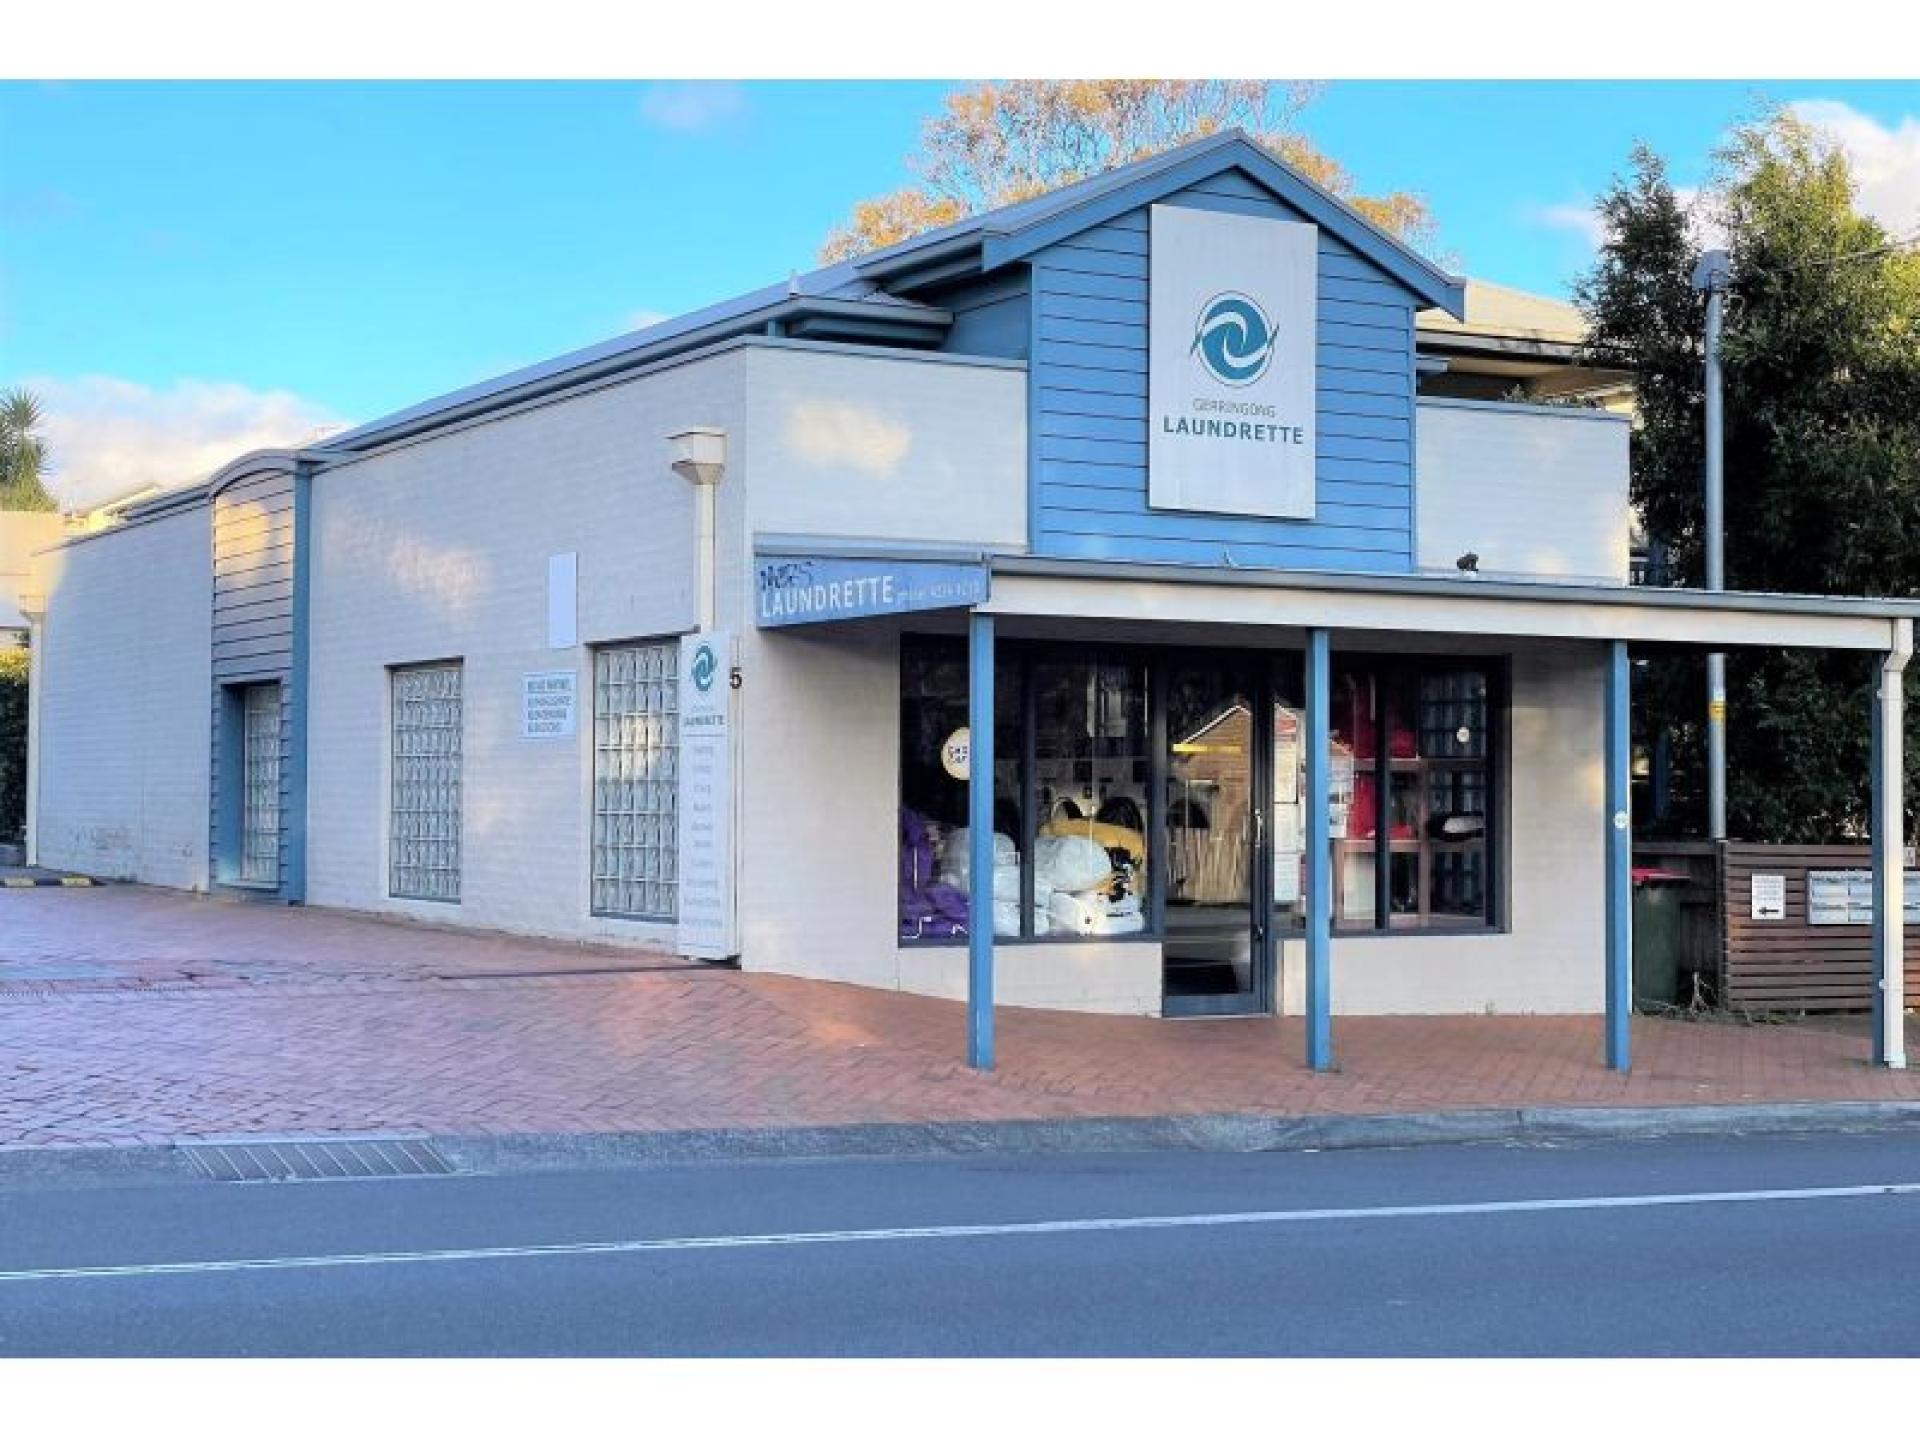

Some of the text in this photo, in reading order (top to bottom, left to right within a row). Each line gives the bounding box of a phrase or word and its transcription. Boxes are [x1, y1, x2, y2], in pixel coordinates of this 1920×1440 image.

[1193, 398, 1276, 418] GERRINGONG
[1163, 415, 1304, 445] LAUNDRETTE
[762, 575, 894, 618] LAUNDRETTE
[730, 667, 743, 690] 5
